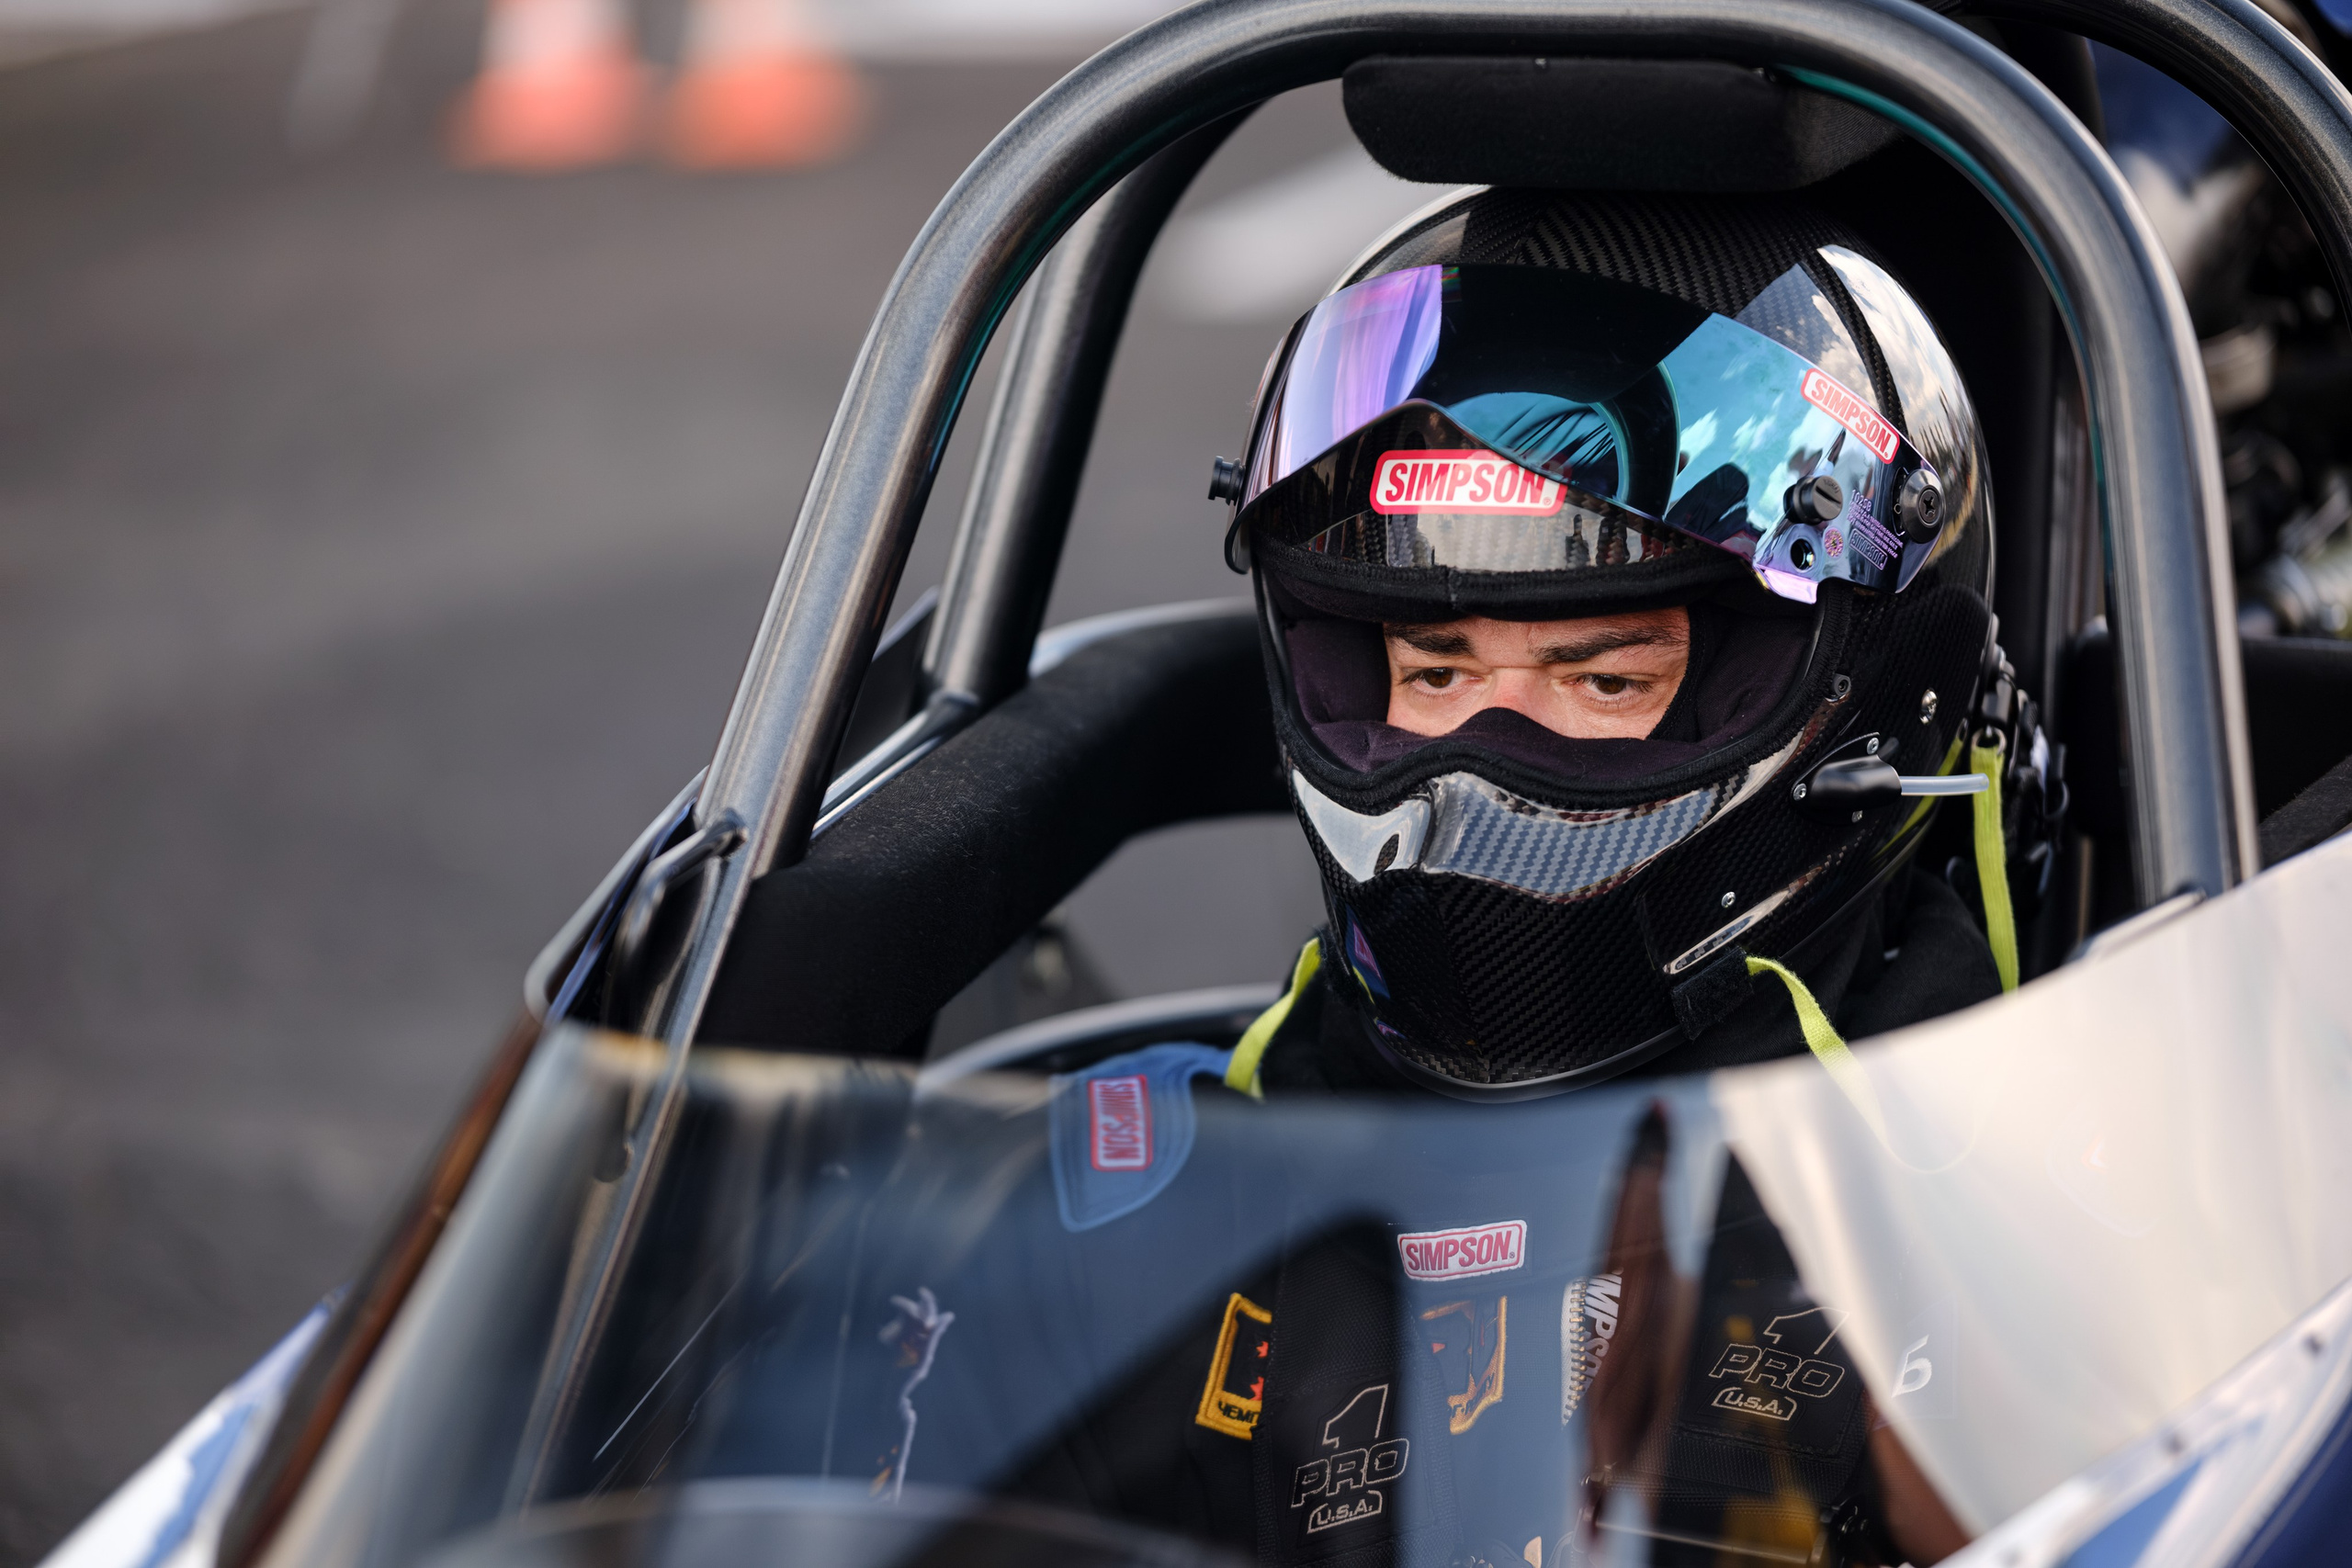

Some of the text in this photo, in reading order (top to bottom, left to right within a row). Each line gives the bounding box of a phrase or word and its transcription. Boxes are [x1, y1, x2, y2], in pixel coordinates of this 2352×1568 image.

[1811, 378, 1892, 453] SIMPSON
[1385, 462, 1546, 504] SIMPSON
[1850, 532, 1885, 566] SIMPSON
[1099, 1082, 1141, 1159] SIMPSON
[1406, 1230, 1513, 1271] SIMPSON
[1708, 1343, 1846, 1398] PRO
[1724, 1392, 1784, 1415] U.S.A.
[1290, 1438, 1410, 1508] PRO
[1316, 1498, 1374, 1526] U.S.A.
